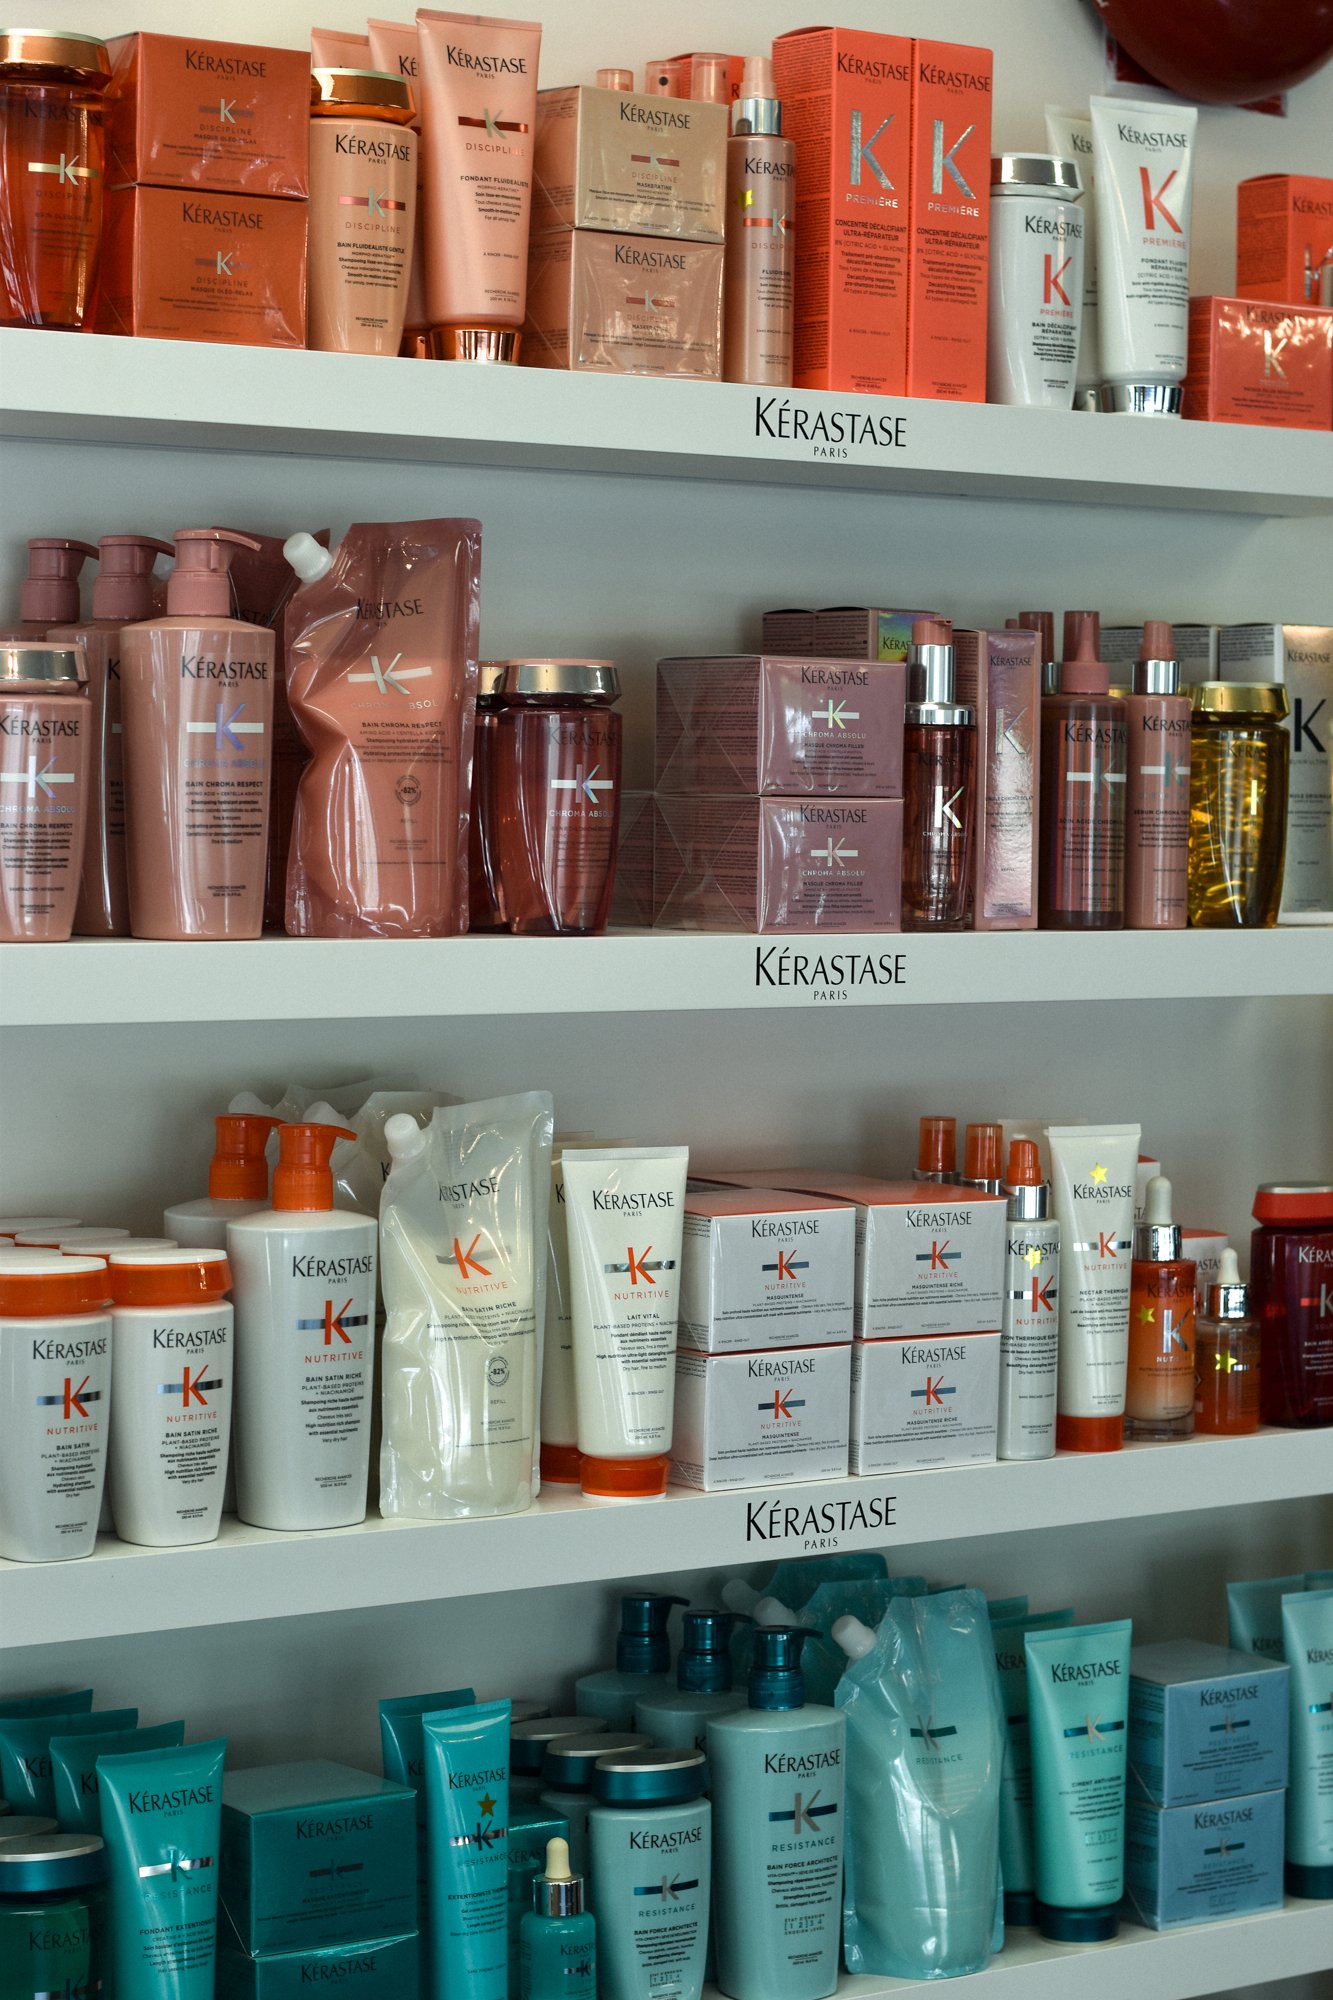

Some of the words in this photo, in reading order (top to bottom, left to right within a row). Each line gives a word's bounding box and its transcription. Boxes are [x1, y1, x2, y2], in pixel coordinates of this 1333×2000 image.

[186, 49, 267, 78] KÉRASTASE
[446, 45, 528, 74] KÉRASTASE
[837, 52, 910, 82] KÉRASTASE
[920, 63, 991, 92] KÉRASTASE
[220, 98, 237, 124] K
[620, 102, 691, 130] KÉRASTASE
[484, 108, 507, 139] K
[1117, 123, 1188, 148] KÉRASTASE
[336, 134, 411, 161] KÉRASTASE
[851, 110, 895, 190] K
[932, 119, 976, 199] K
[60, 153, 78, 186] K
[460, 175, 492, 183] FONDANT
[368, 187, 388, 218] K
[846, 193, 899, 209] PREMIÈRE
[928, 202, 980, 217] PREMIÈRE
[1139, 166, 1183, 234] K
[183, 202, 264, 229] KÉRASTASE
[835, 218, 868, 230] CONCENTRÉ
[1025, 215, 1083, 239] KÉRASTASE
[345, 221, 401, 234] DISCIPLINE
[843, 230, 899, 242] ULTRA-RÉPARATEUR
[337, 241, 352, 249] BAIN
[216, 251, 233, 276] K
[615, 244, 687, 270] KÉRASTASE
[197, 276, 249, 288] DISCIPLINE
[1043, 254, 1072, 306] K
[644, 289, 658, 313] K
[755, 397, 907, 448] KÉRASTASE
[813, 446, 848, 458] PARIS
[181, 655, 268, 680] KÉRASTASE
[990, 655, 1032, 667] KÉRASTASE
[370, 653, 410, 694] K
[801, 666, 869, 686] KÉRASTASE
[411, 721, 442, 729] RESPECT
[828, 699, 847, 729] K
[1294, 698, 1327, 752] K
[216, 703, 245, 751] K
[837, 732, 866, 740] ABSOLU
[996, 706, 1028, 755] K
[28, 755, 57, 799] K
[575, 764, 600, 804] K
[549, 809, 586, 817] CHROMA
[800, 804, 868, 824] KÉRASTASE
[934, 785, 964, 828] K
[827, 837, 845, 867] K
[756, 946, 907, 986] KÉRASTASE
[813, 990, 847, 1000] PARIS
[592, 1189, 675, 1211] KÉRASTASE
[1073, 1184, 1132, 1199] KÉRASTASE
[752, 1219, 820, 1238] KÉRASTASE
[906, 1210, 972, 1228] KÉRASTASE
[454, 1233, 492, 1279] K
[931, 1240, 950, 1270] K
[1100, 1231, 1117, 1258] K
[292, 1255, 373, 1278] KÉRASTASE
[627, 1245, 656, 1285] K
[778, 1249, 798, 1280] K
[918, 1272, 959, 1280] NUTRITIVE
[1084, 1263, 1128, 1271] NUTRITIVE
[456, 1281, 508, 1294] NUTRITIVE
[614, 1290, 670, 1300] NUTRITIVE
[764, 1281, 807, 1291] NUTRITIVE
[766, 1293, 805, 1301] MASQUINTENSE
[1032, 1274, 1054, 1313] K
[495, 1301, 517, 1310] RICHE
[324, 1298, 353, 1345] K
[1163, 1308, 1191, 1353] K
[32, 1338, 107, 1360] KÉRASTASE
[153, 1327, 227, 1349] KÉRASTASE
[304, 1351, 364, 1363] NUTRITIVE
[902, 1346, 966, 1364] KÉRASTASE
[749, 1359, 816, 1378] KÉRASTASE
[182, 1364, 209, 1407] K
[926, 1375, 945, 1406] K
[63, 1375, 90, 1420] K
[774, 1388, 793, 1419] K
[166, 1411, 218, 1423] NUTRITIVE
[906, 1418, 943, 1426] MASQUINTENSE
[913, 1407, 953, 1416] NUTRITIVE
[47, 1423, 98, 1435] NUTRITIVE
[760, 1420, 802, 1430] NUTRITIVE
[762, 1431, 800, 1440] MASQUINTENSE
[161, 1438, 199, 1446] PLANT-BASED
[746, 1496, 897, 1541] KÉRASTASE
[804, 1537, 838, 1550] PARIS
[1052, 1660, 1122, 1683] KÉRASTASE
[1200, 1685, 1259, 1707] KÉRASTASE
[764, 1749, 841, 1774] KÉRASTASE
[449, 1768, 507, 1790] KÉRASTASE
[129, 1786, 214, 1814] KÉRASTASE
[164, 1809, 184, 1817] PARIS
[794, 1789, 822, 1835] K
[1195, 1807, 1253, 1829] KÉRASTASE
[297, 1814, 374, 1840] KÉRASTASE
[476, 1819, 493, 1851] K
[630, 1827, 702, 1850] KÉRASTASE
[771, 1836, 836, 1853] RESISTANCE
[784, 1861, 805, 1869] FORCE
[806, 1855, 838, 1867] ARCHITECTE
[661, 1873, 680, 1902] K
[638, 1903, 696, 1917] RESISTANCE
[139, 1926, 174, 1936] FONDANT
[649, 1926, 668, 1934] FORCE
[668, 1921, 698, 1931] ARCHITECTE
[302, 1956, 377, 1983] KÉRASTASE
